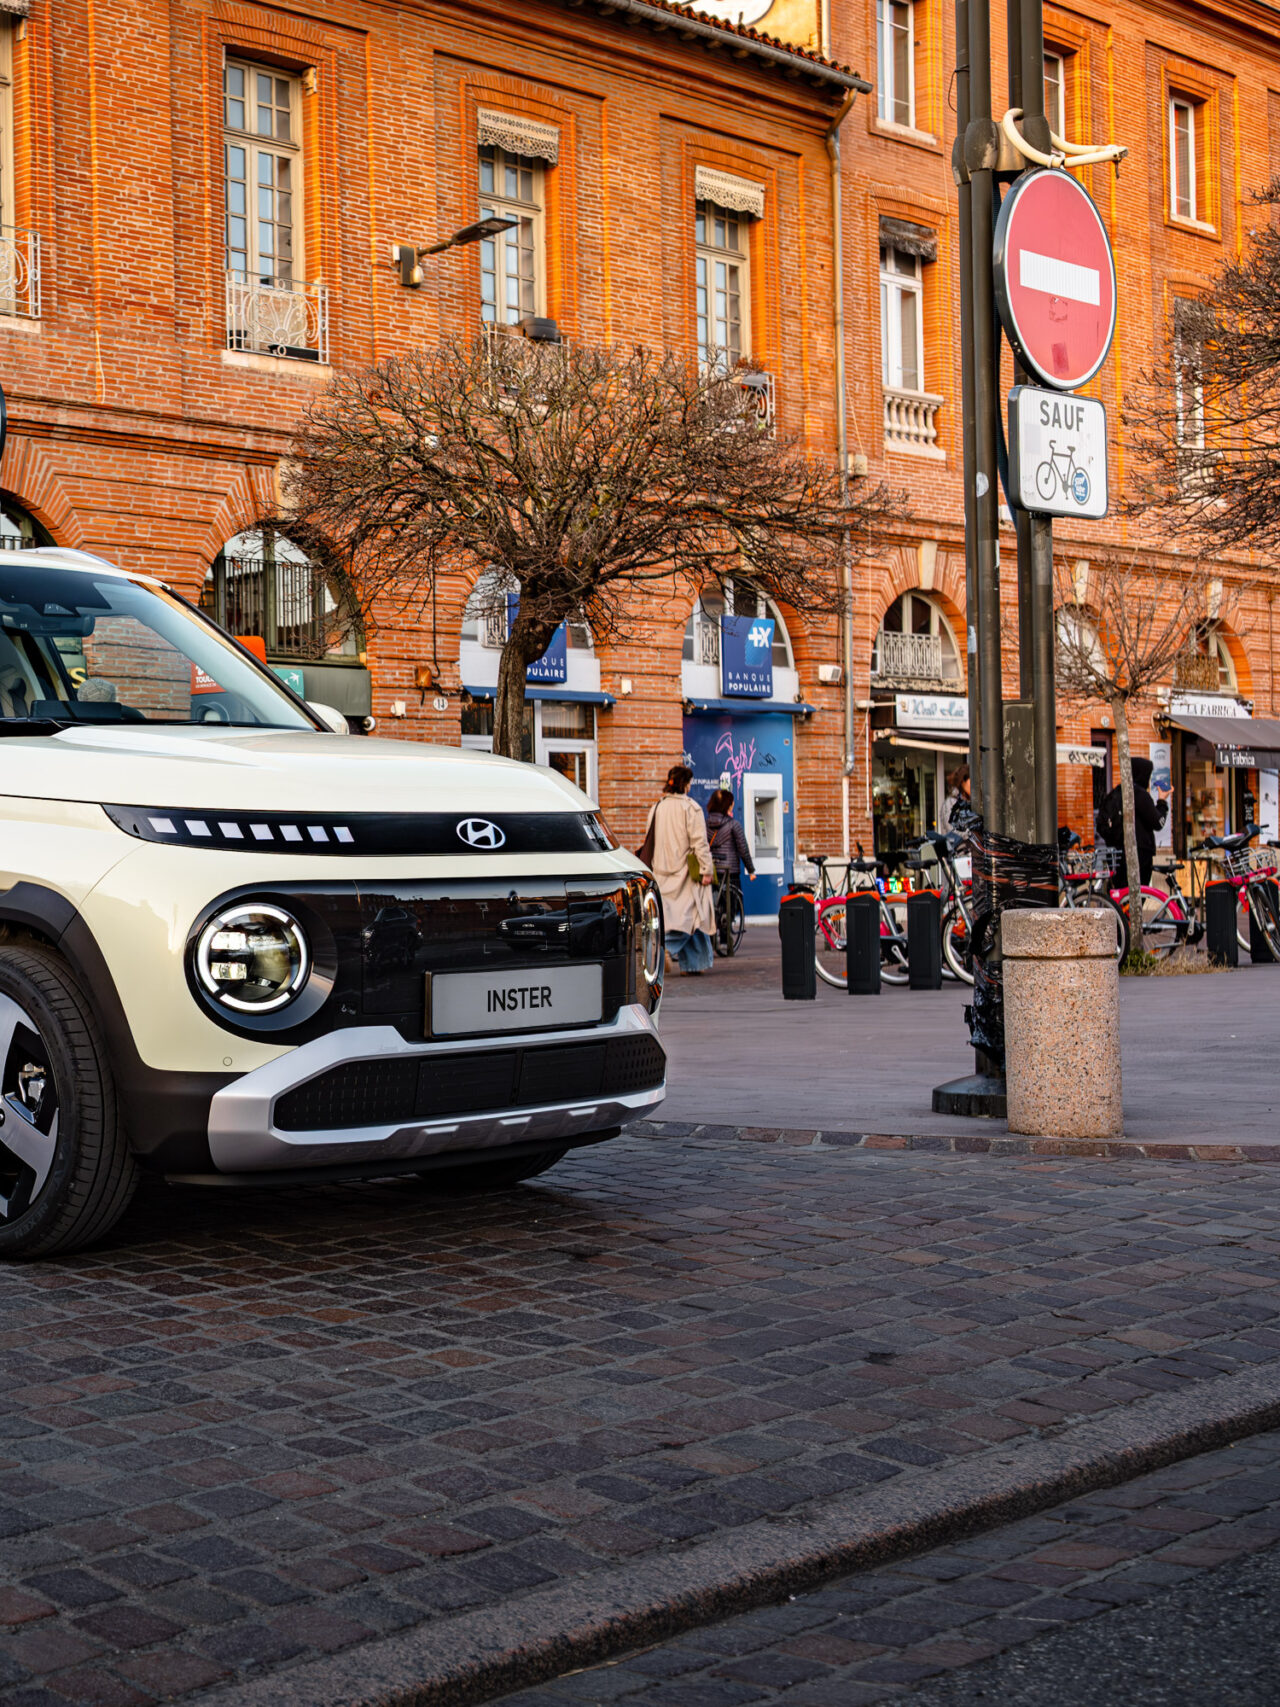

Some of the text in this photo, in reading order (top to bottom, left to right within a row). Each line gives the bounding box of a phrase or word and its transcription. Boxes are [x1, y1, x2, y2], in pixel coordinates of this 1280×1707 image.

[1040, 400, 1085, 432] SAUF
[527, 668, 564, 678] PULAIRE
[728, 672, 771, 682] BANQUE
[728, 683, 771, 693] POPULAIRE
[1201, 704, 1236, 717] FABRICA
[1220, 751, 1255, 766] La Fabrica
[487, 986, 552, 1012] INSTER
